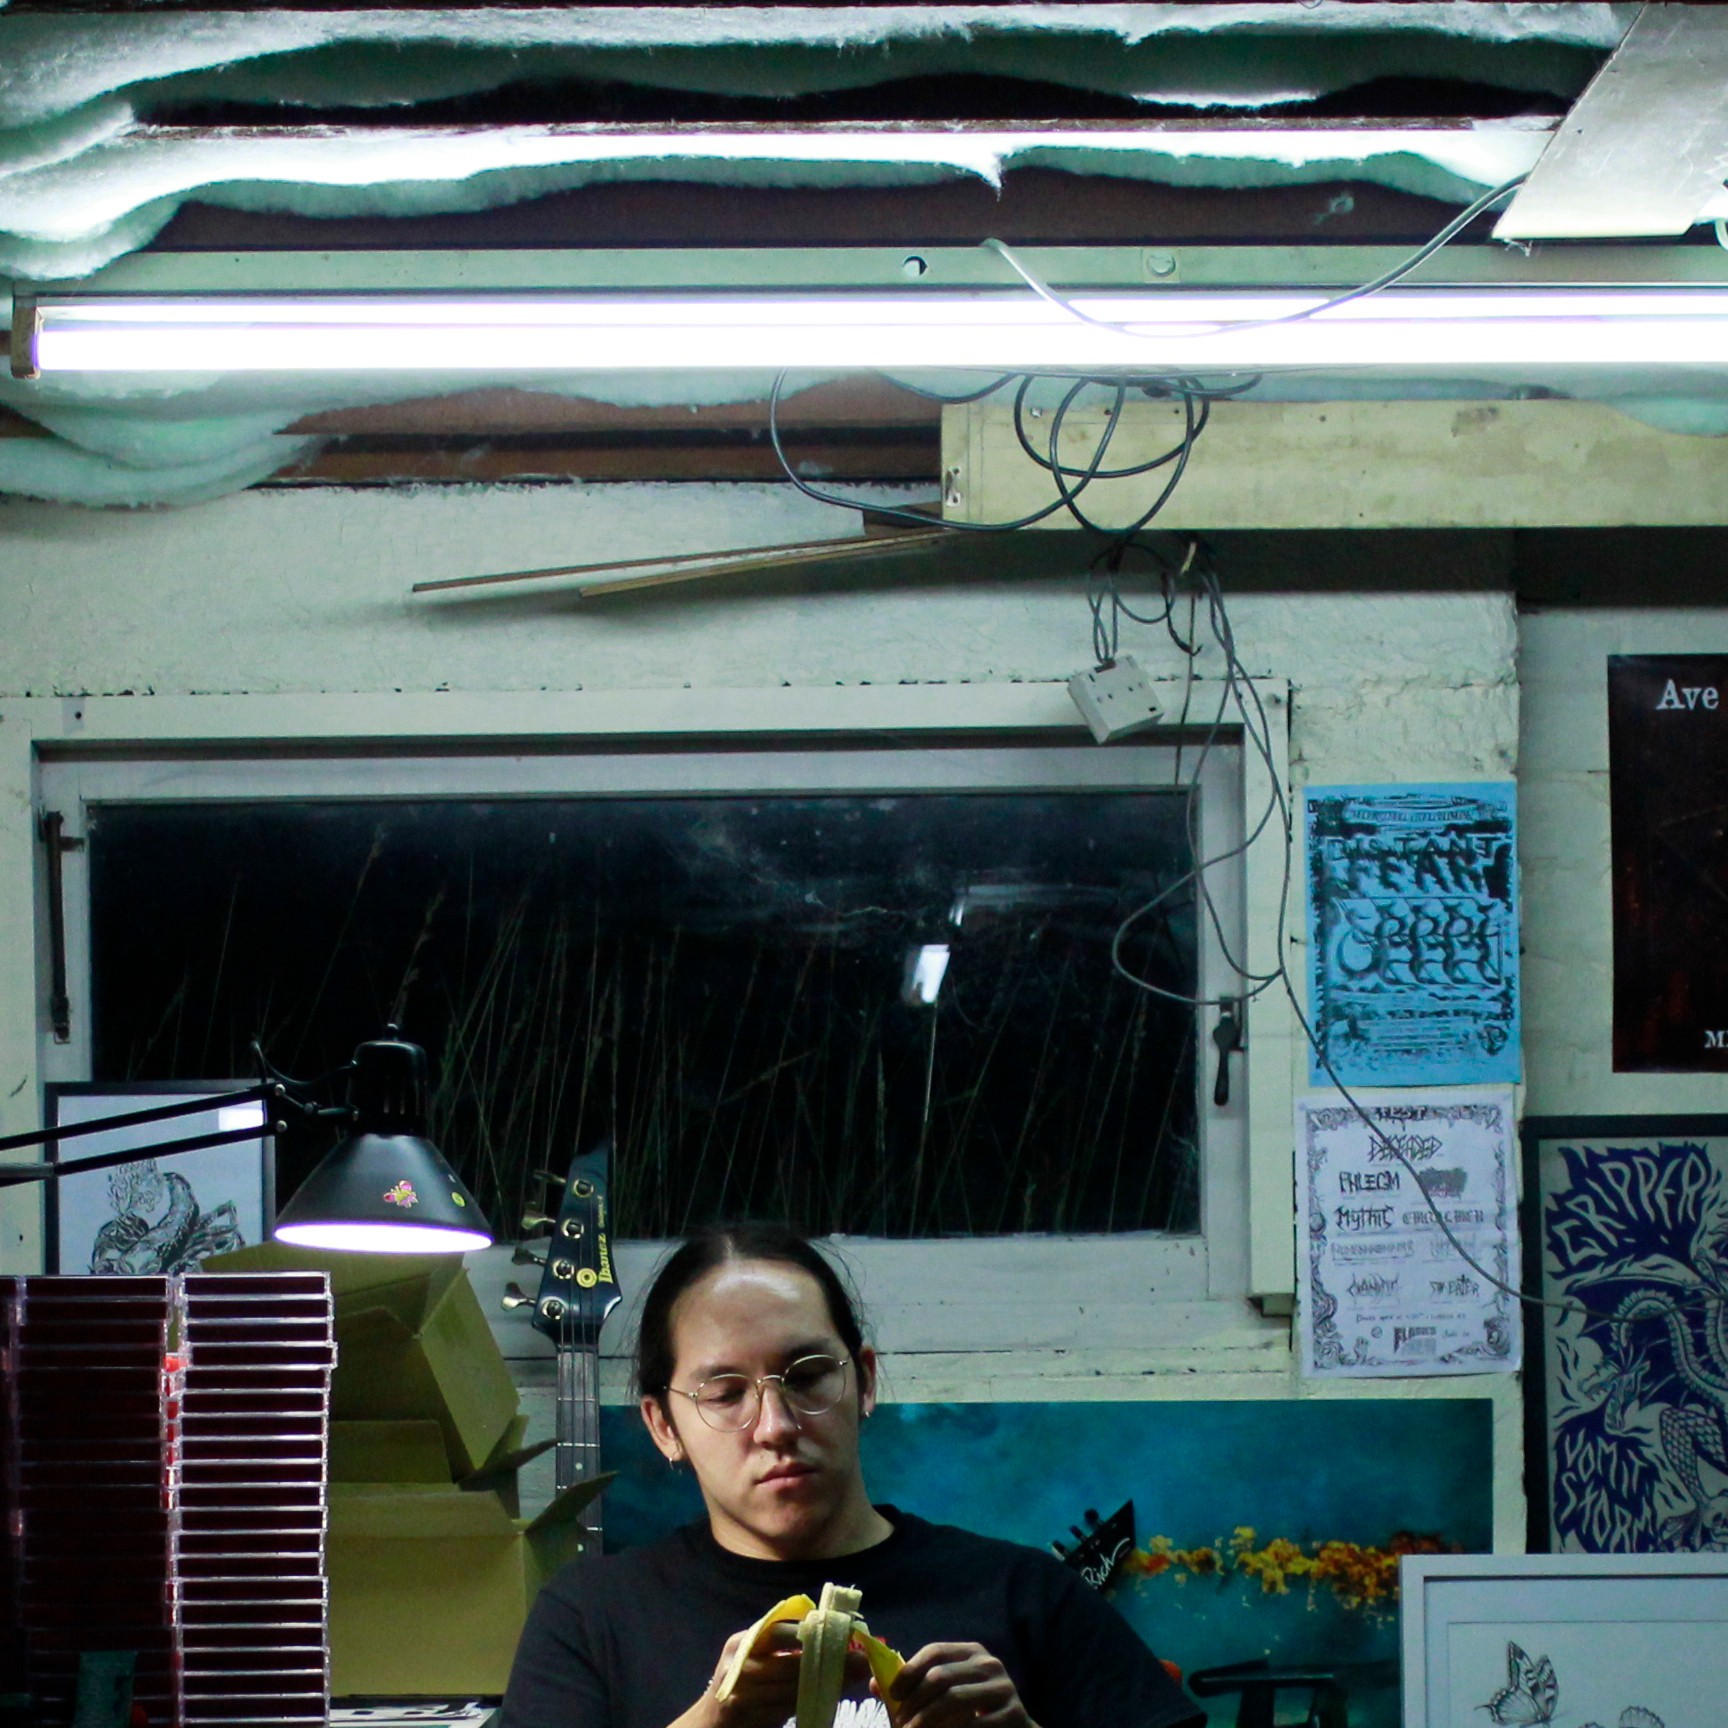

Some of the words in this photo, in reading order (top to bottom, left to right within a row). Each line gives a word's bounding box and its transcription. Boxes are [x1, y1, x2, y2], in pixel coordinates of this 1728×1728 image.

[1656, 678, 1719, 710] Ave
[1553, 1147, 1709, 1267] GRIPPER
[598, 1232, 613, 1284] Ibanez
[1563, 1430, 1645, 1492] VOMIT
[1081, 1537, 1130, 1590] Rich
